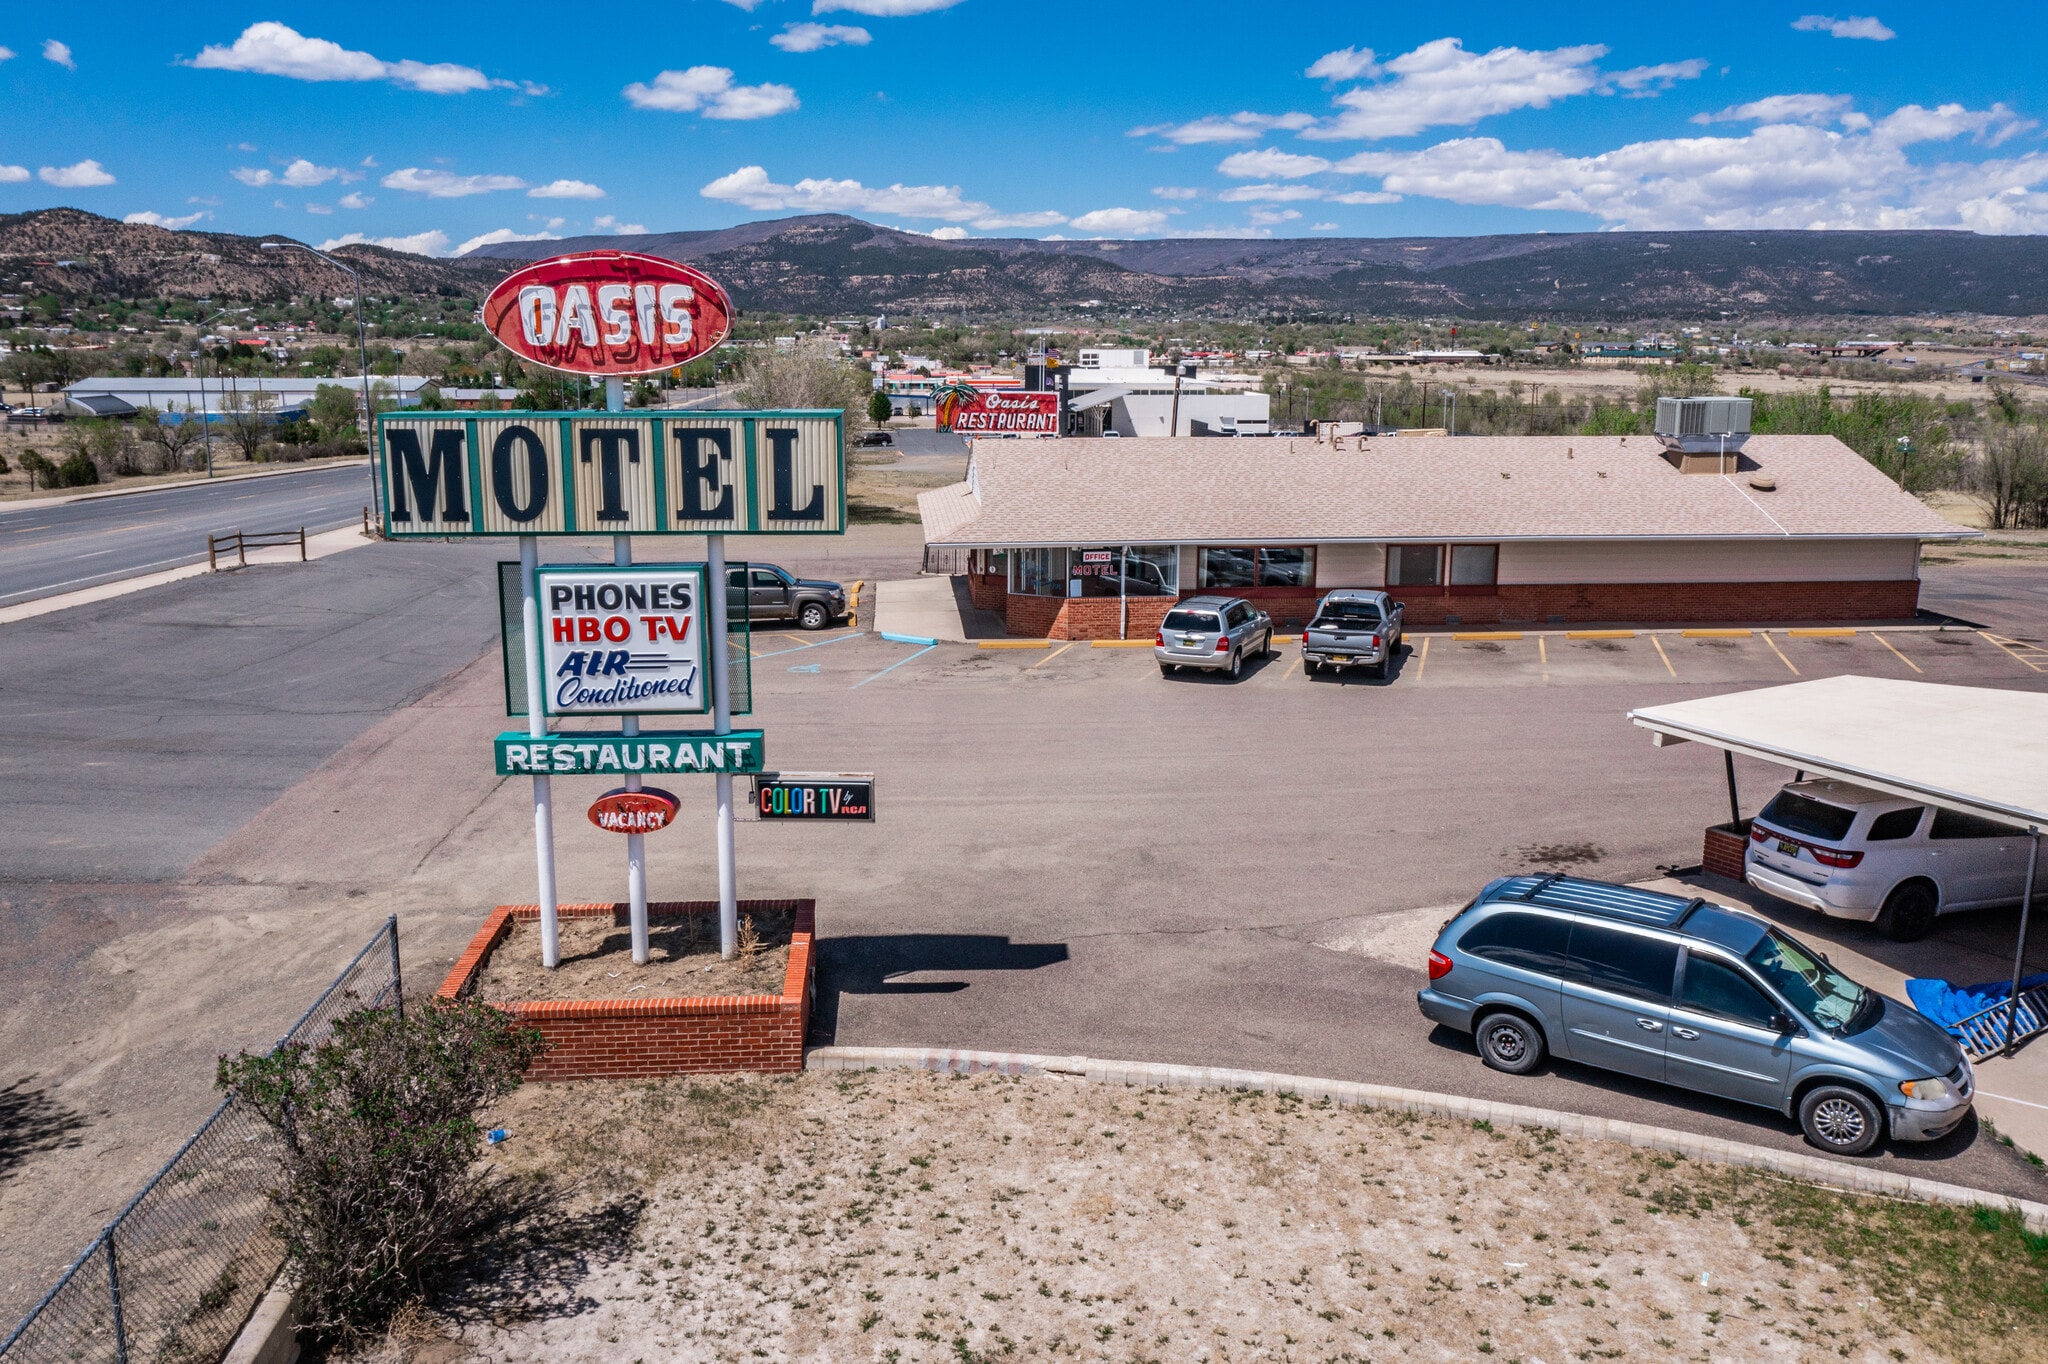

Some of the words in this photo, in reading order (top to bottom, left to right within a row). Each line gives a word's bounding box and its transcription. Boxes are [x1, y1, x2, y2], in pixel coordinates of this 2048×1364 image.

[518, 284, 695, 347] OASIS
[985, 393, 1040, 409] Oasis
[957, 412, 1057, 430] RESTAURANT
[386, 425, 825, 522] MOTEL
[1073, 565, 1118, 576] MOTEL
[1084, 553, 1110, 561] OFFICE
[550, 583, 692, 611] PHONES
[552, 616, 631, 643] HBO
[556, 650, 631, 678] AIR
[556, 666, 697, 708] Conditioned
[506, 742, 751, 771] RESTAURANT
[761, 787, 816, 815] COLOR
[819, 788, 842, 815] TV
[841, 806, 867, 814] RCA
[843, 790, 854, 806] by
[599, 811, 665, 829] VACANCY
